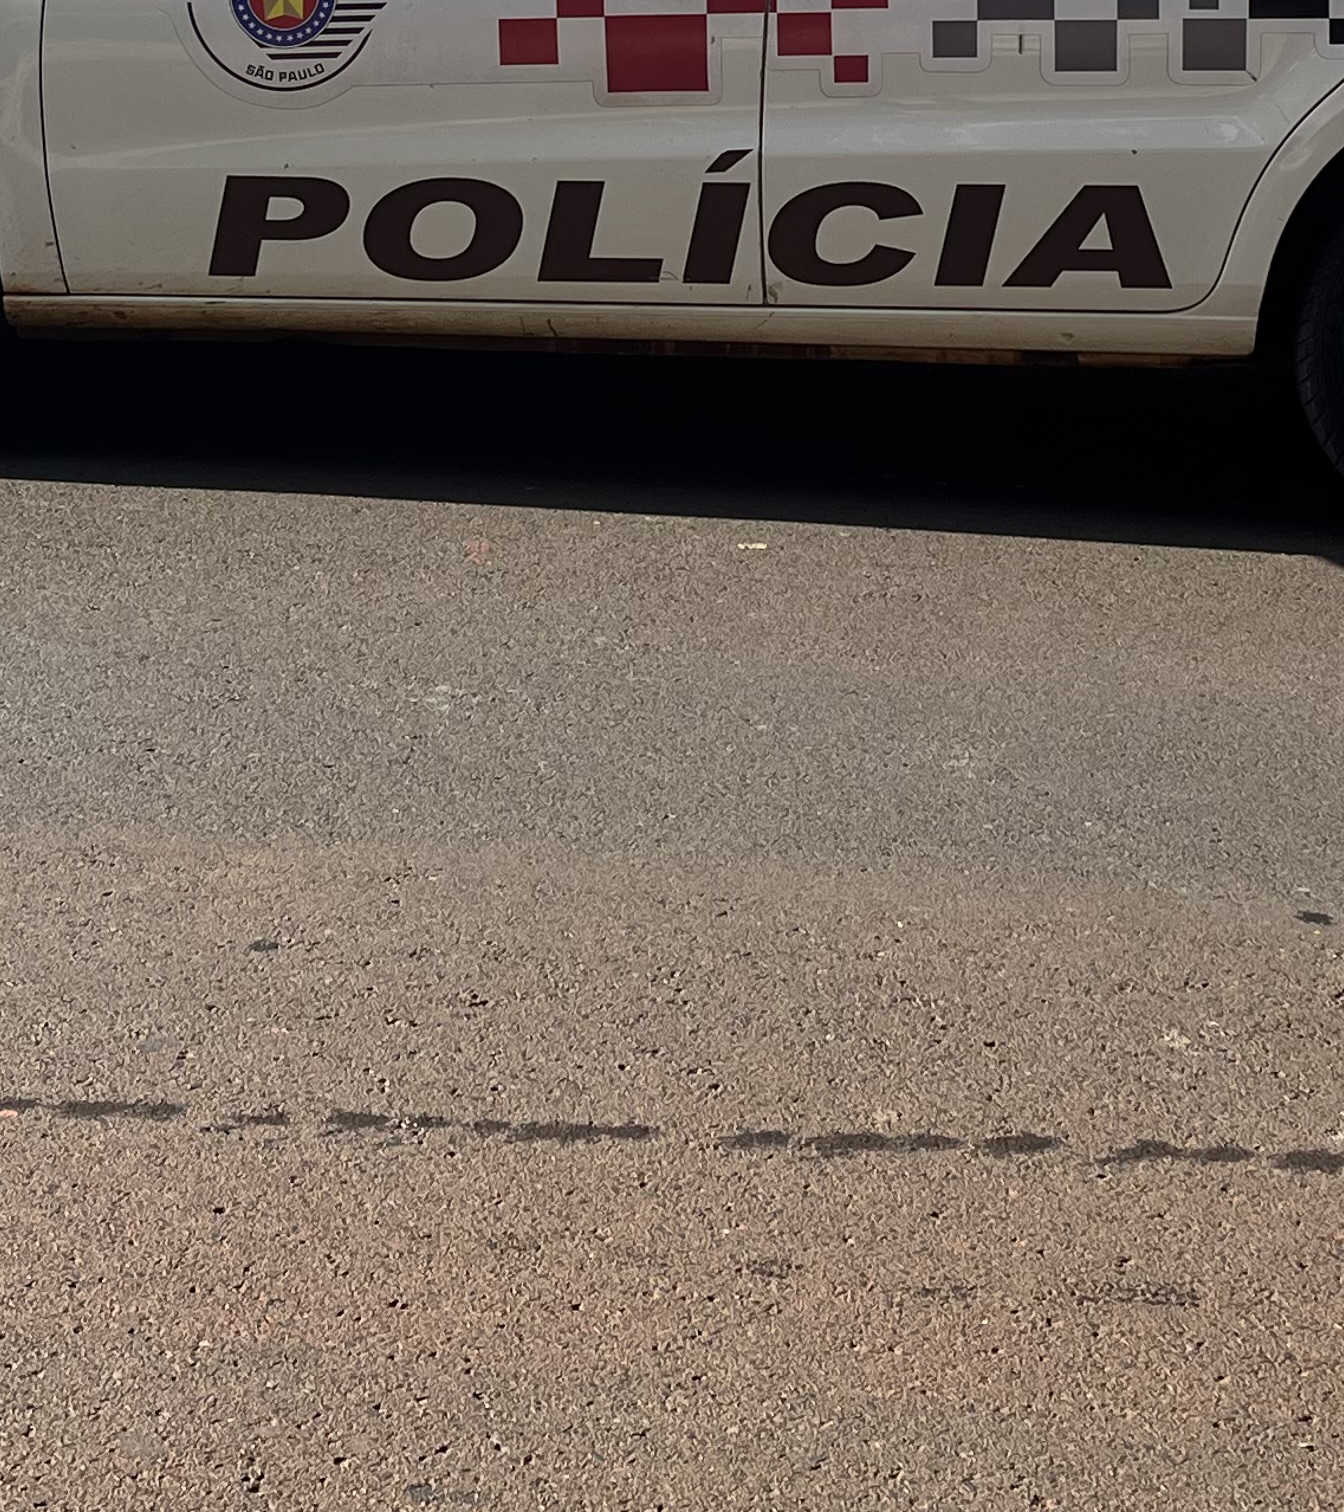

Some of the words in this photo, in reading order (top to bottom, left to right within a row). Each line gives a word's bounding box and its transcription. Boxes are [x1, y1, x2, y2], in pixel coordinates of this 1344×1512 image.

[245, 64, 274, 82] SÃO
[278, 62, 325, 82] PAULO
[208, 149, 1173, 290] POLÍCIA
